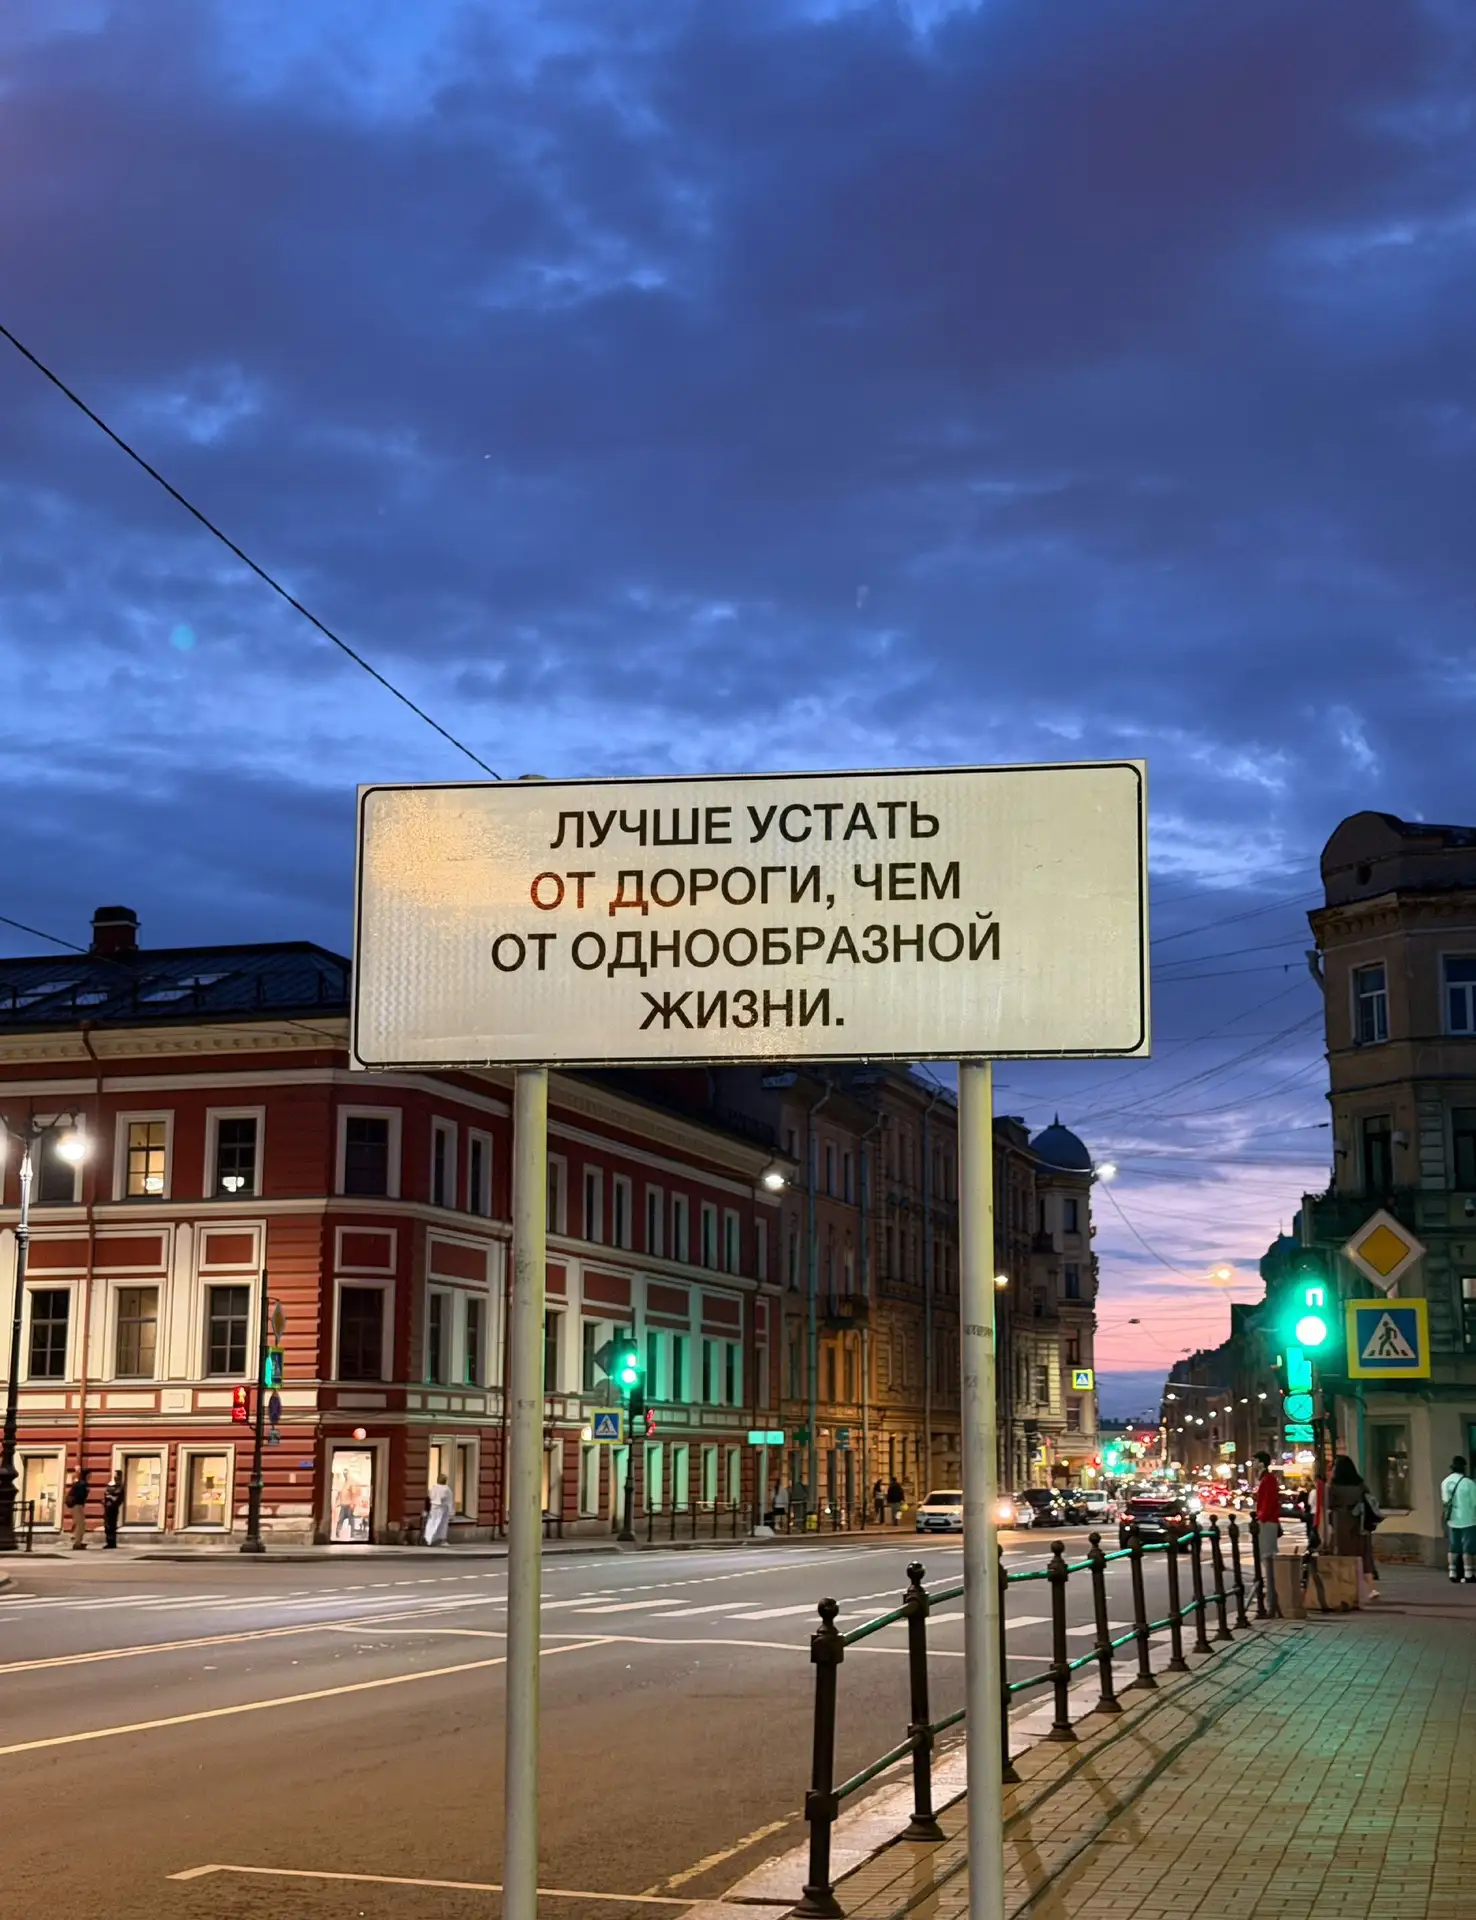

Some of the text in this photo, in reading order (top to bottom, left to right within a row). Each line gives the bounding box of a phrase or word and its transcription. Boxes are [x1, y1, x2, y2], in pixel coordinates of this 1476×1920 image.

[551, 802, 939, 848] ЛУЧШЕ УСТАТЬ
[532, 861, 959, 916] ОТ ДОРОГИ, ЧЕМ
[492, 912, 1000, 977] ОТ ОДНООБРАЗНОЙ
[640, 989, 844, 1029] ЖИЗНИ.
